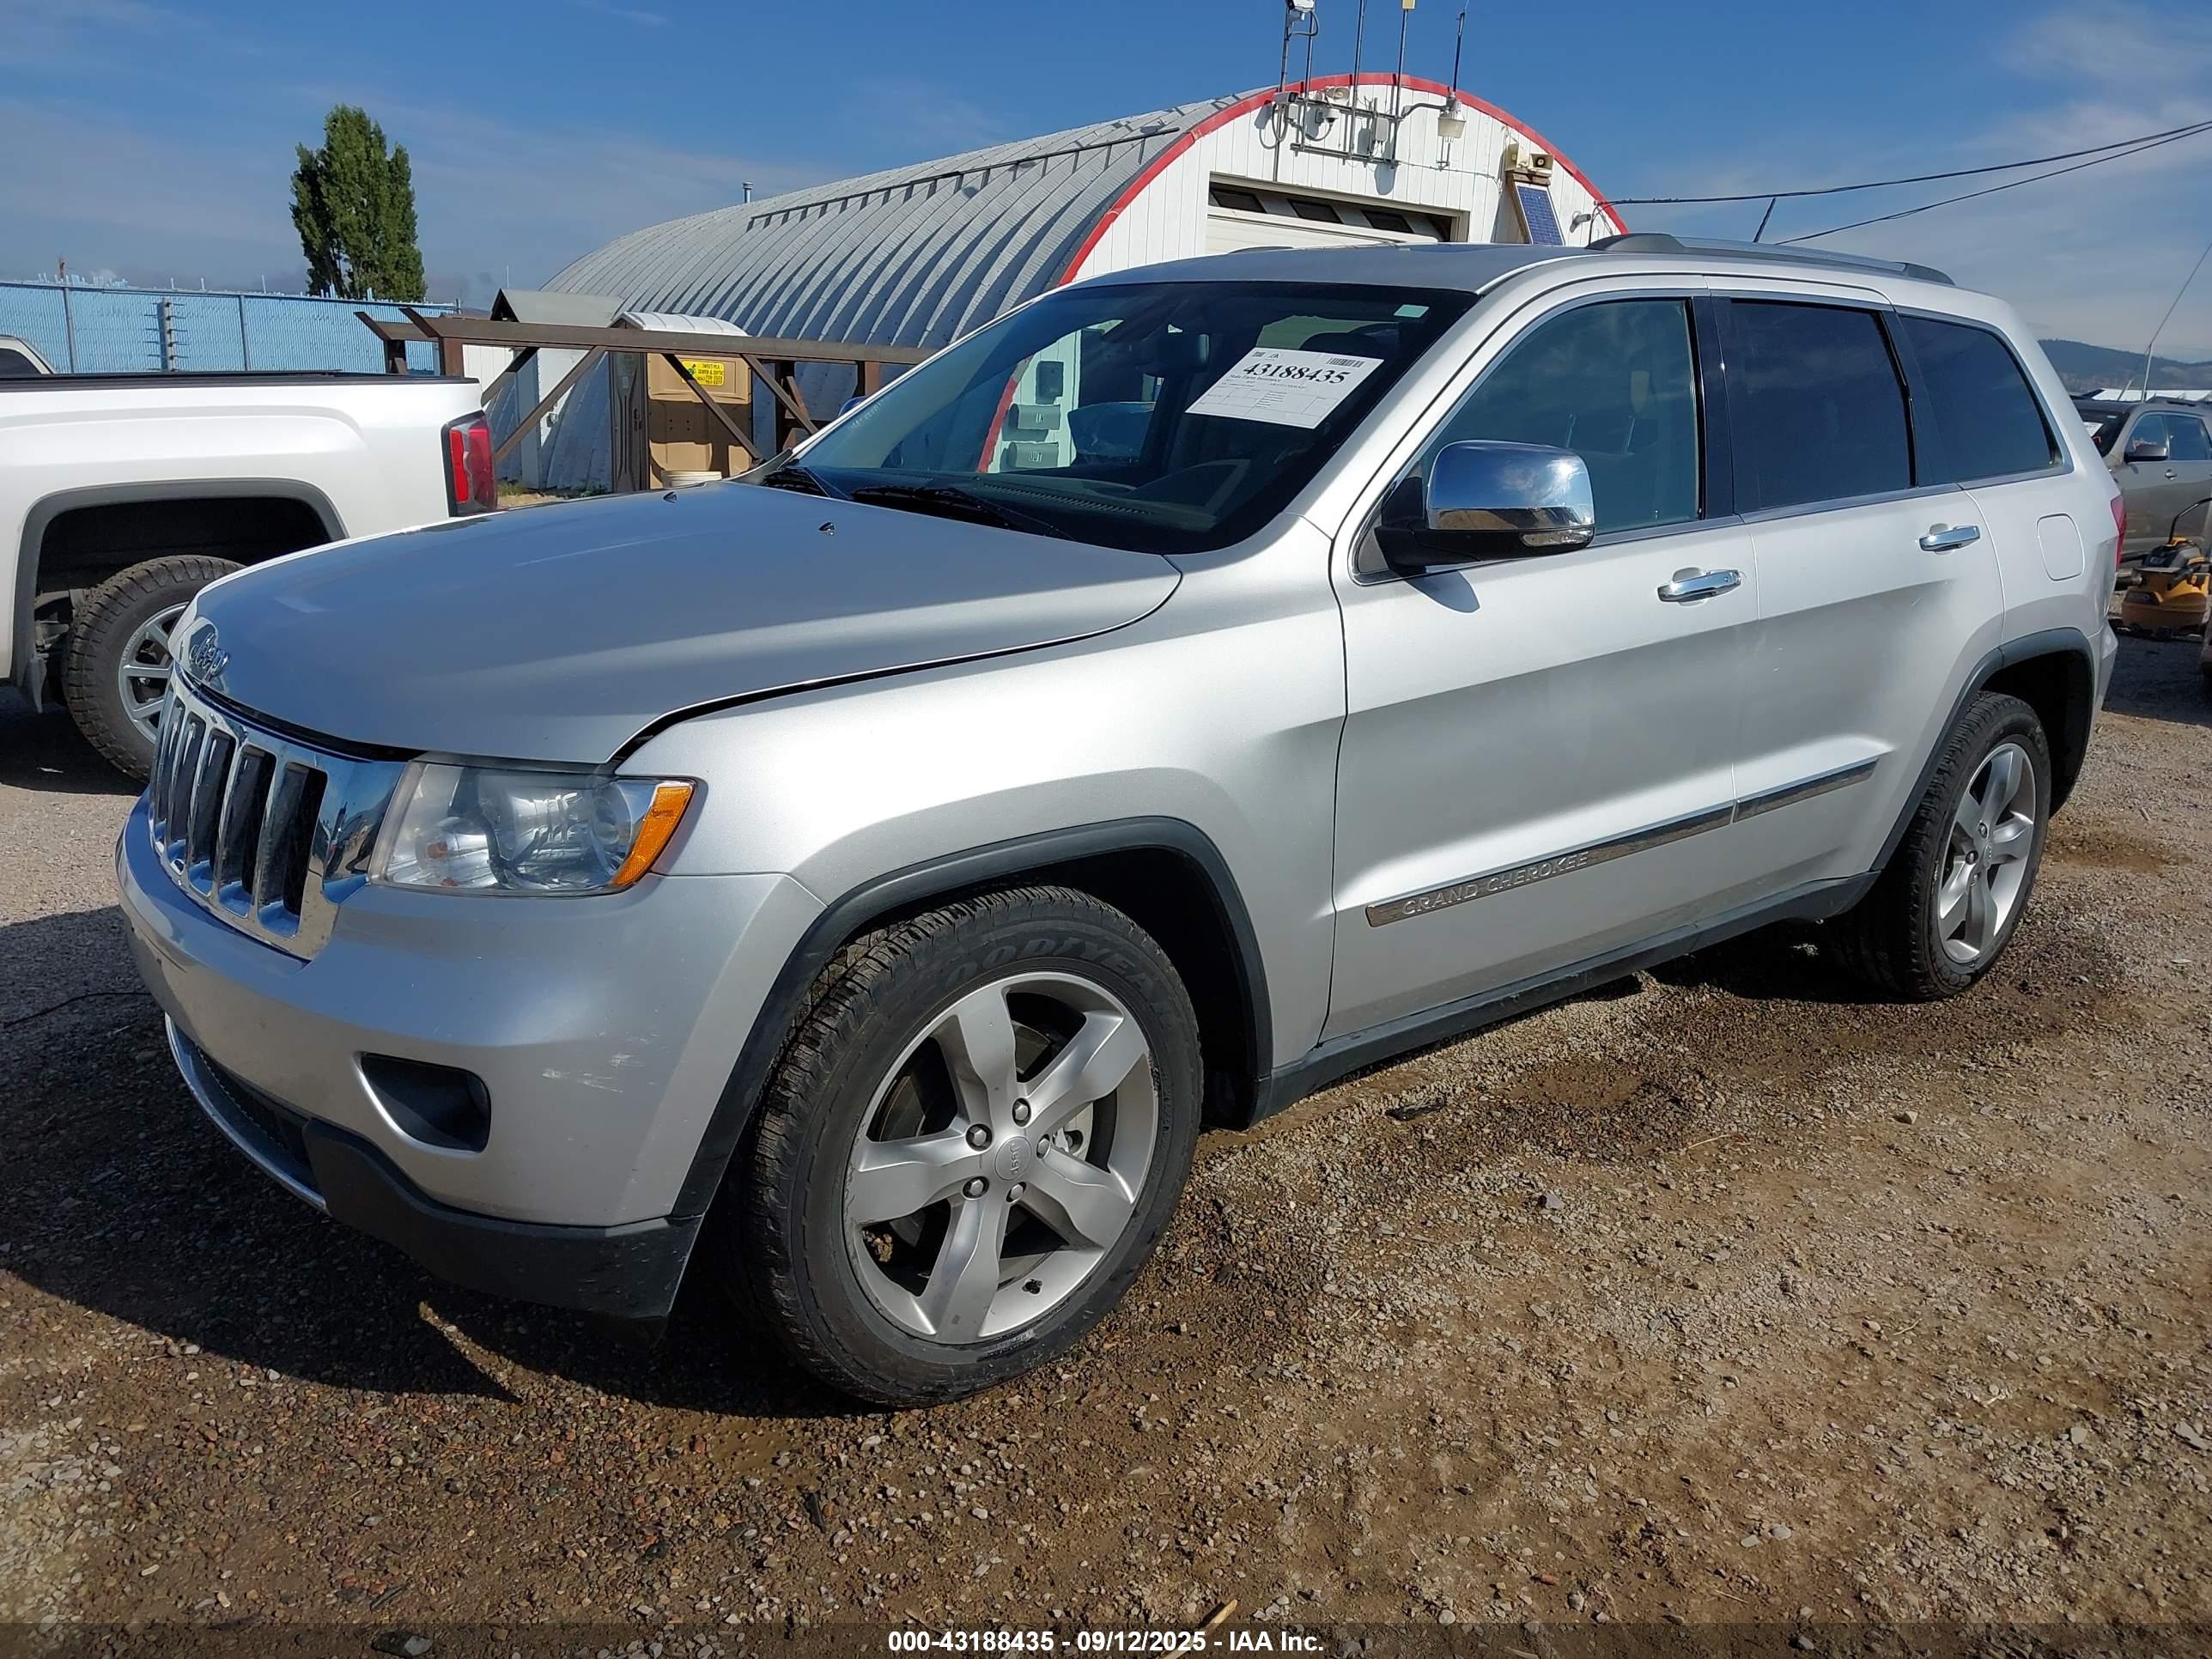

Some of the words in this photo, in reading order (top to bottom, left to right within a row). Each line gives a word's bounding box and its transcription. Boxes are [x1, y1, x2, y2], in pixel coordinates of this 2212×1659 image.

[1242, 362, 1351, 384] 43188435
[1029, 451, 1043, 463] OUT
[1401, 884, 1479, 915] GRAND
[1486, 851, 1589, 892] CHEROKEE
